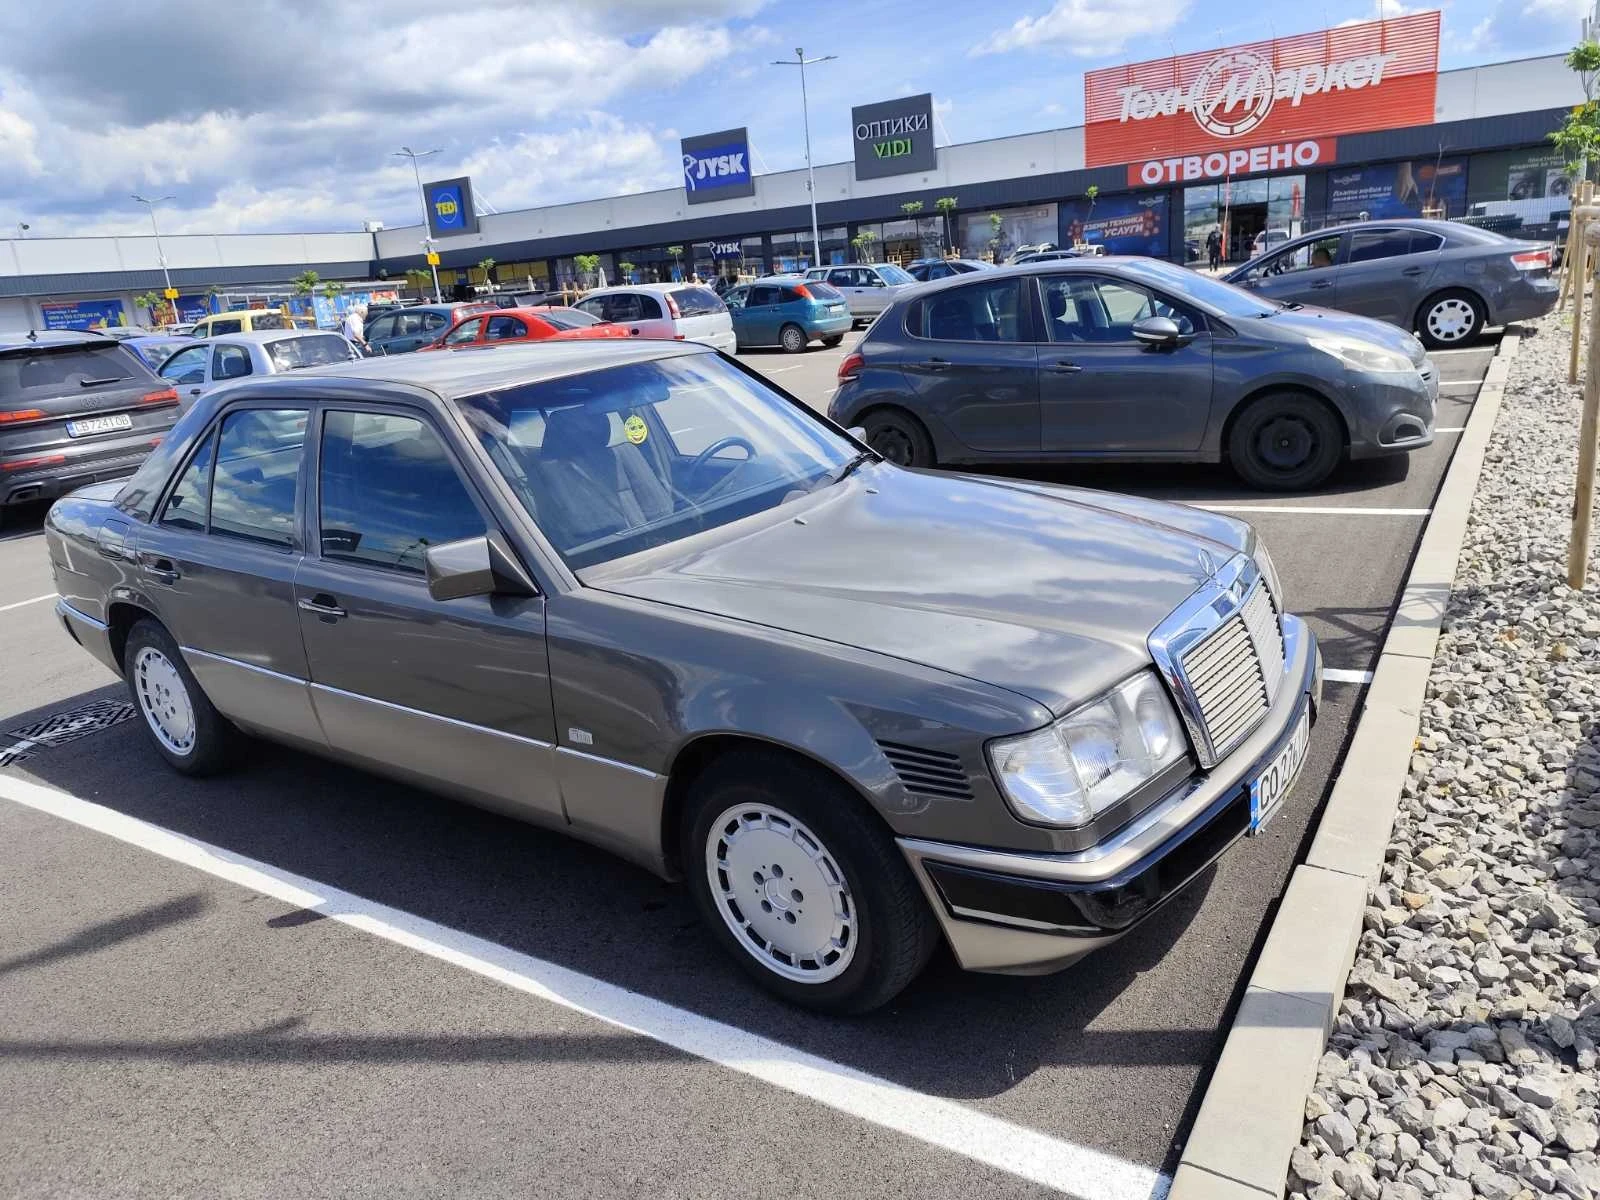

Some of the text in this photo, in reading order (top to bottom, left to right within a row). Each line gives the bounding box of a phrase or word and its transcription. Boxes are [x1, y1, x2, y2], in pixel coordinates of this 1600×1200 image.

[856, 113, 929, 140] ОПТИКИ
[873, 138, 912, 159] VIDI
[696, 152, 746, 181] JYSK
[1140, 140, 1321, 185] ОТВОРЕНО
[1104, 223, 1144, 237] УСЛУГИ
[716, 239, 740, 254] JYSK
